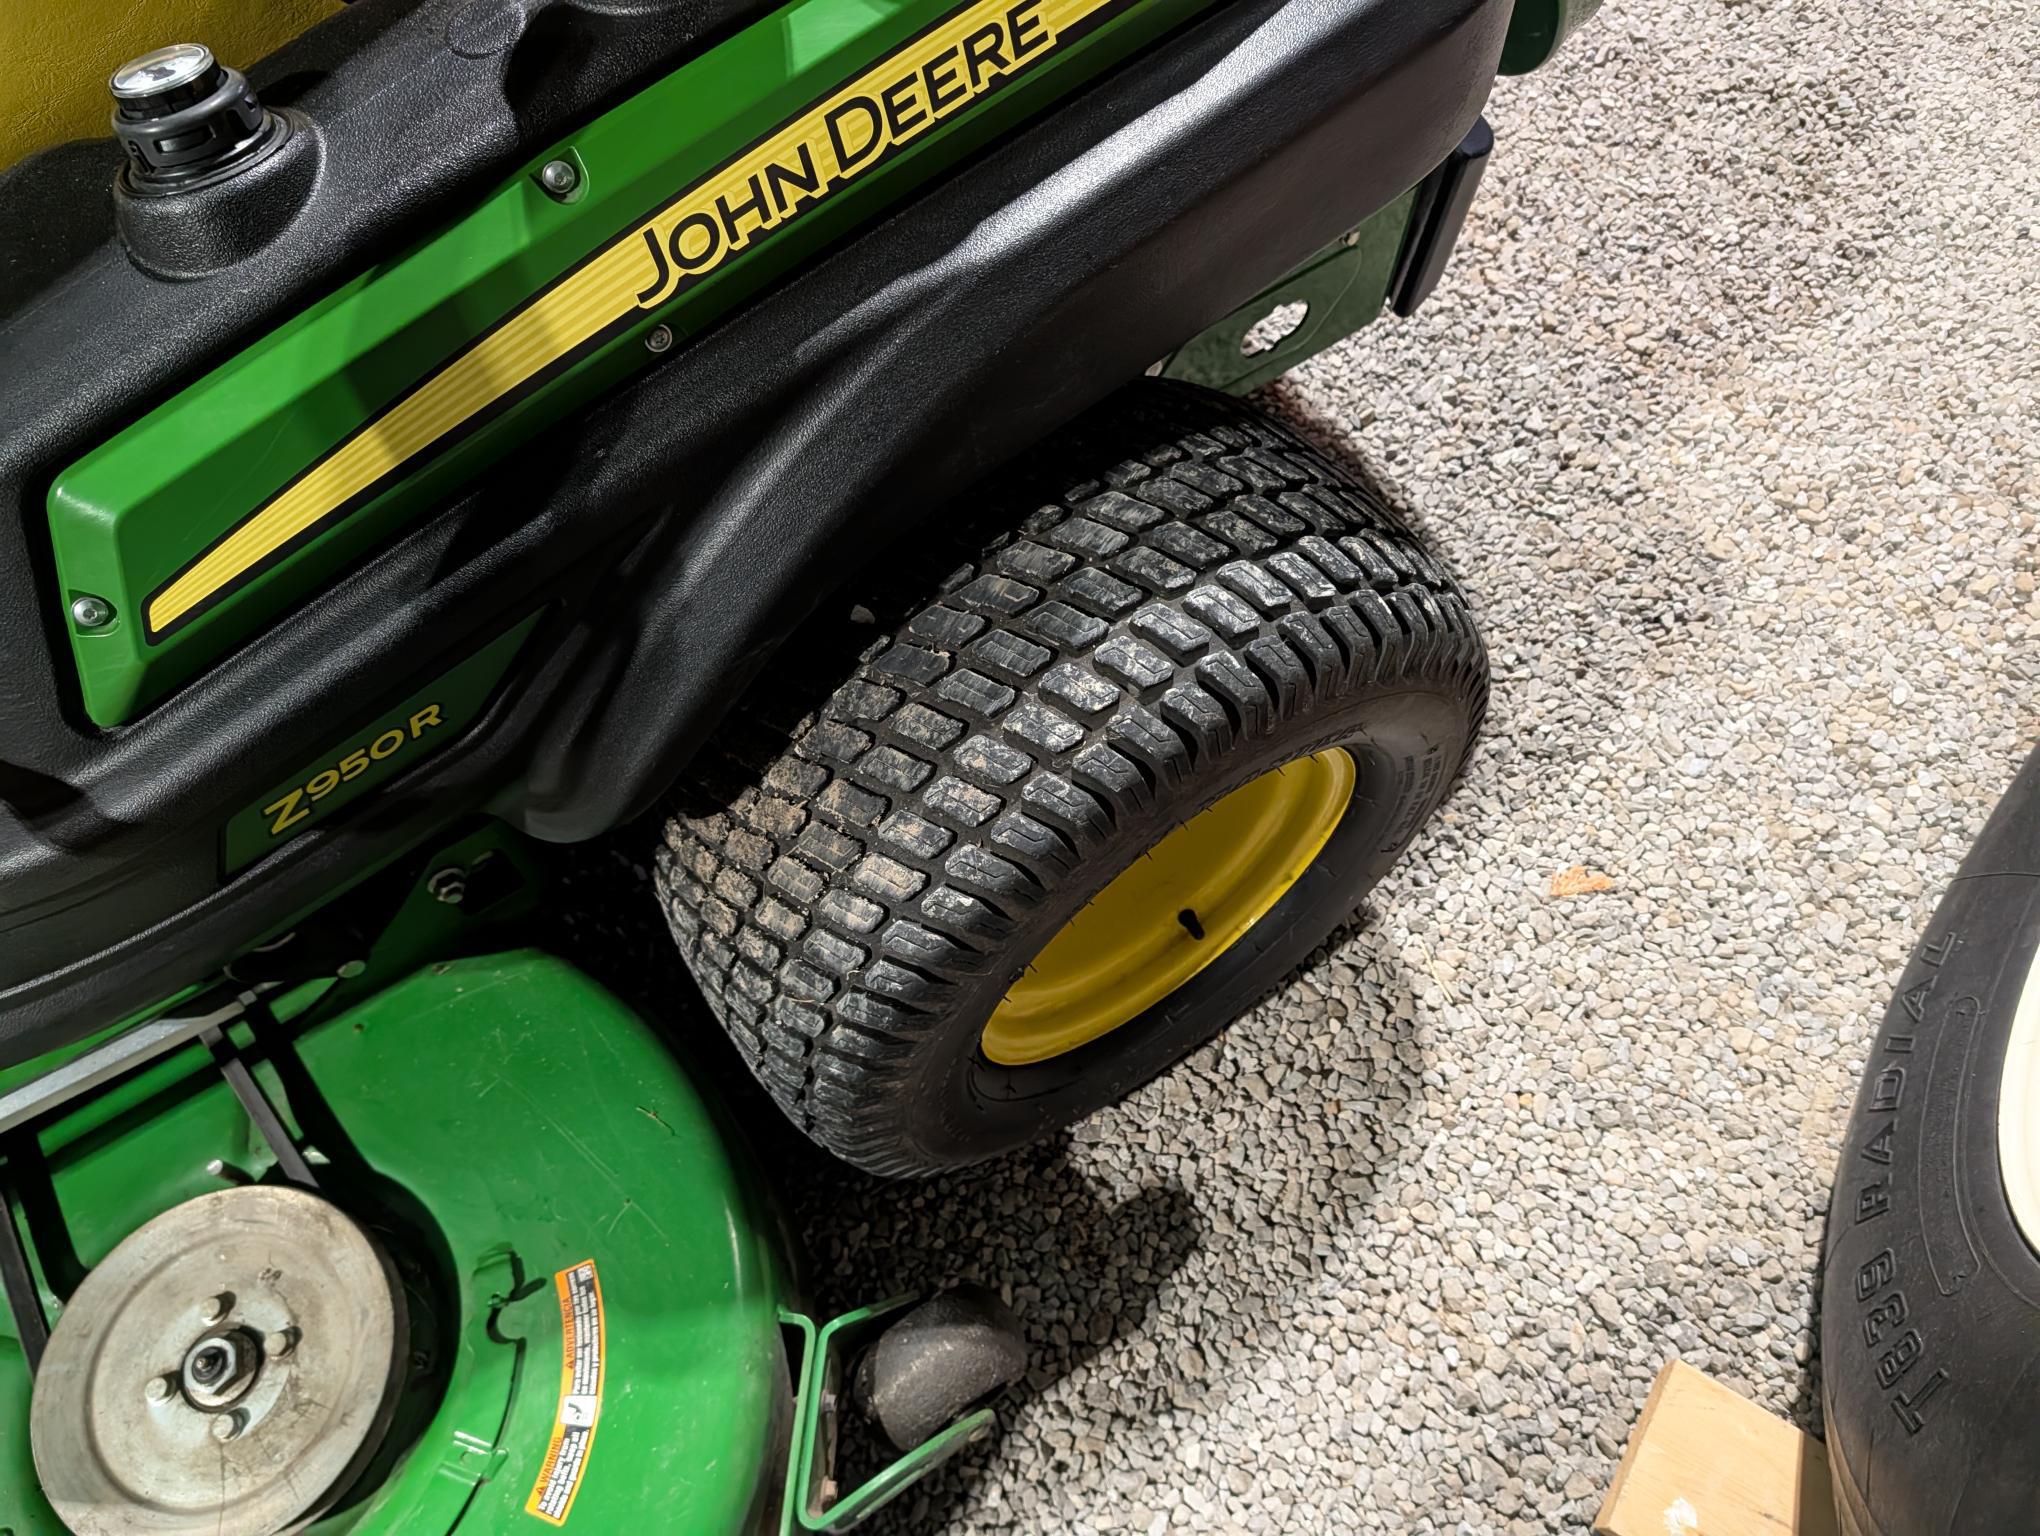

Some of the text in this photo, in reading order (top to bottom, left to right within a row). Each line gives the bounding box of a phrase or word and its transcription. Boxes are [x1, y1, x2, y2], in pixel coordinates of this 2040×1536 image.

[637, 0, 1052, 304] JOHN DEERE
[263, 704, 443, 836] Z950R
[1854, 930, 1958, 1226] RADIAL
[561, 1298, 576, 1360] ADVERTENCIA
[1855, 1247, 1951, 1437] T839
[540, 1436, 562, 1483] WARNING
